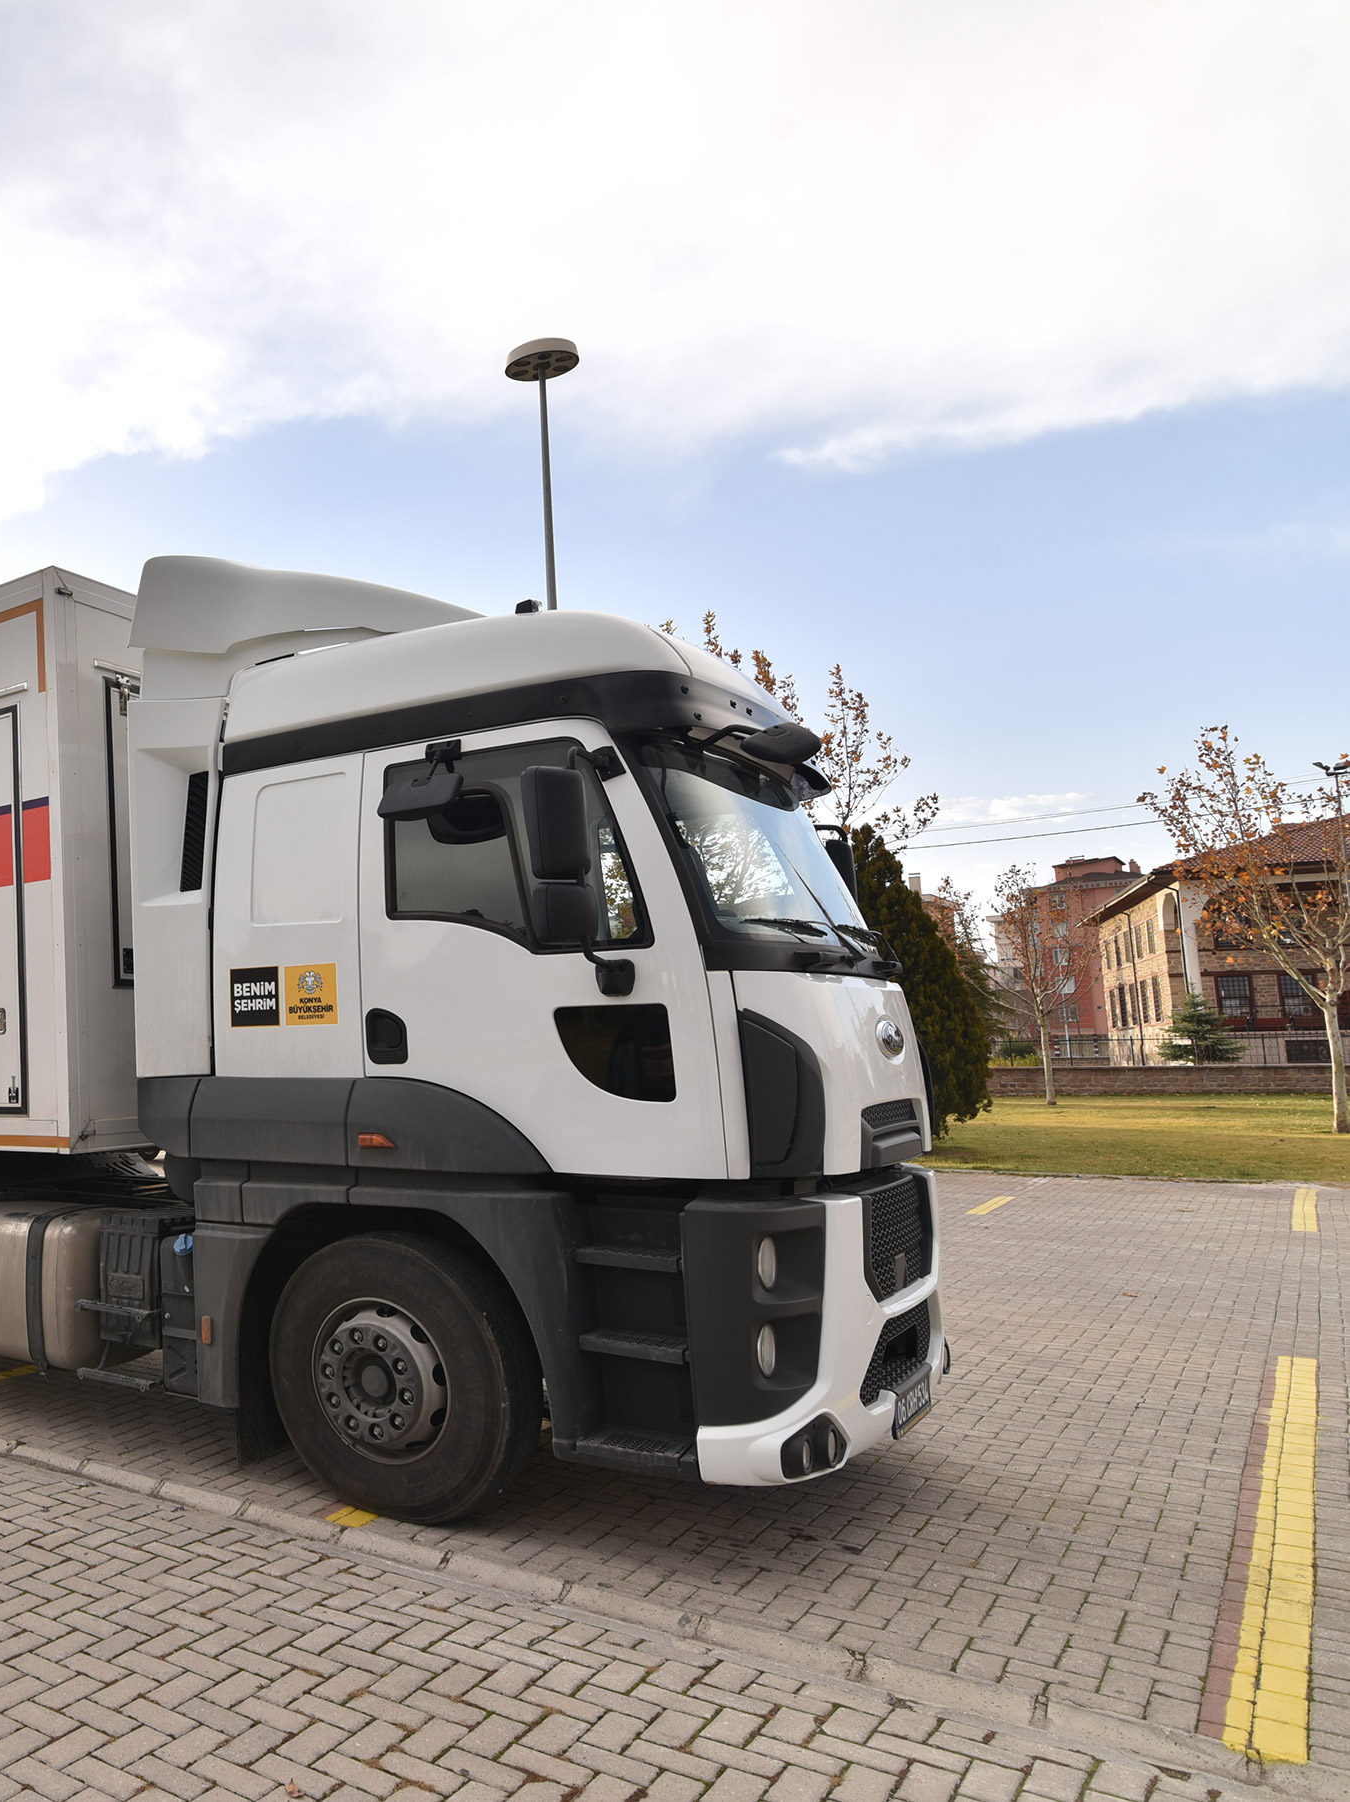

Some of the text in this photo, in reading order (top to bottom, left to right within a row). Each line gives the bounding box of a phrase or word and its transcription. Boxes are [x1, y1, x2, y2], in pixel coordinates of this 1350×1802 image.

[233, 981, 276, 997] BENİM
[234, 998, 276, 1013] ŞEHRİM
[289, 1003, 334, 1014] BÜYÜKŞEHİR
[897, 1398, 907, 1425] 06
